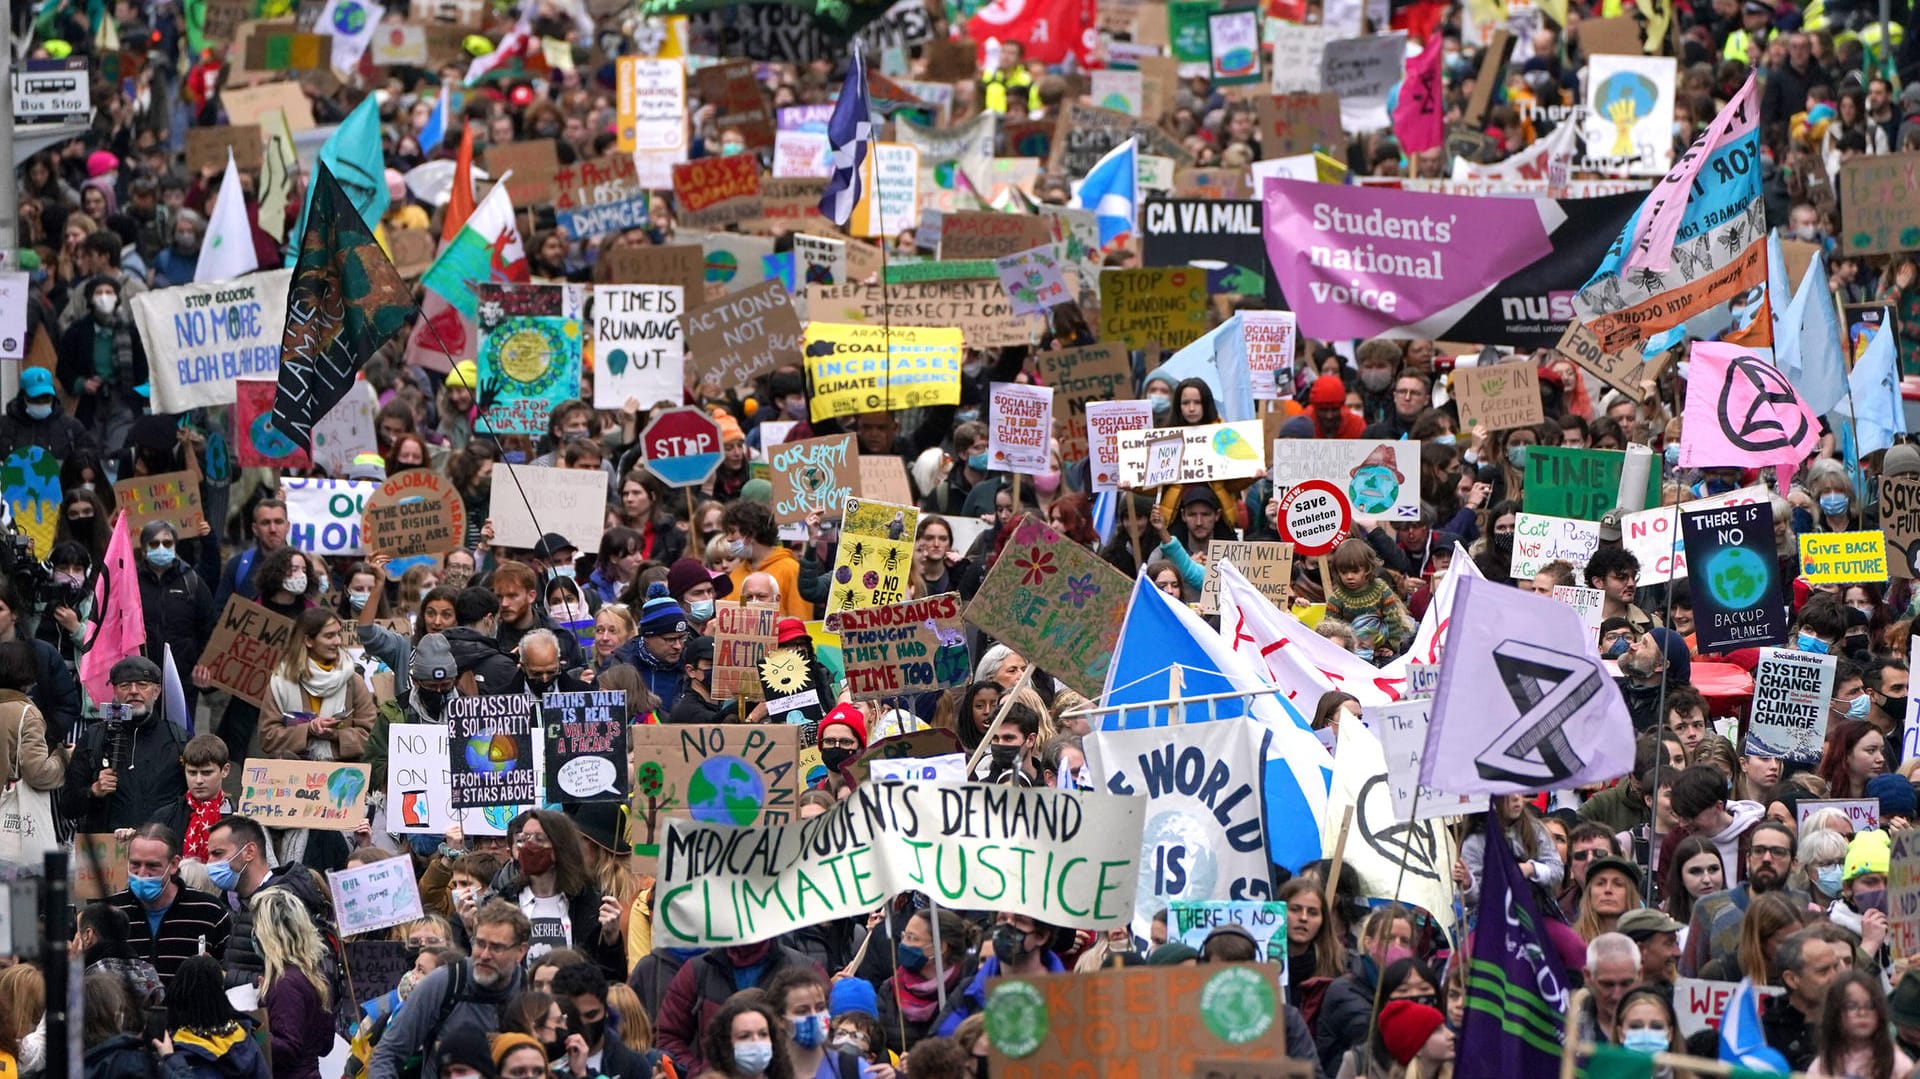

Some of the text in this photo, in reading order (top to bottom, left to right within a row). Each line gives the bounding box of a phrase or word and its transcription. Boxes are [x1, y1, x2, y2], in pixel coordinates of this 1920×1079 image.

[21, 99, 82, 111] Bus Stop
[674, 161, 732, 192] LOSS
[578, 179, 625, 206] LOSS
[573, 201, 647, 236] DAMAGE
[1179, 203, 1210, 234] VA
[1211, 203, 1261, 234] MAL
[817, 252, 837, 263] NO
[1310, 244, 1443, 281] national
[1110, 271, 1163, 295] STOP
[185, 292, 213, 308] STOP
[605, 289, 676, 312] TIME IS
[1113, 299, 1187, 315] FUNDING
[1309, 280, 1398, 314] voice
[688, 283, 788, 335] ACTIONS
[1501, 294, 1577, 322] nus
[174, 302, 262, 348] NO MORE
[599, 316, 681, 341] RUNNING
[722, 316, 766, 348] NOT
[1107, 317, 1169, 335] CLIMATE
[836, 343, 885, 353] COAL
[1566, 334, 1616, 373] FOOLS
[179, 347, 253, 386] BLAH BLAH
[704, 355, 742, 386] BLAH
[733, 351, 775, 383] BLAH
[818, 357, 958, 379] INCREASES
[818, 377, 876, 395] CLIMATE
[1513, 367, 1530, 389] IN
[514, 400, 549, 411] STOP
[994, 396, 1049, 411] SOCIALIST
[1000, 405, 1043, 419] CHANGE
[1461, 402, 1472, 418] A
[1005, 416, 1037, 428] TO END
[1091, 415, 1149, 427] SOCIALIST
[1484, 409, 1537, 428] FUTURE
[997, 425, 1043, 439] CLIMATE
[999, 434, 1042, 447] CHANGE
[773, 444, 809, 473] OUR
[1157, 445, 1178, 457] NOW
[1277, 440, 1356, 461] CLIMATE
[1160, 458, 1171, 469] OR
[1277, 460, 1350, 481] CHANGE
[1529, 452, 1606, 487] TIME
[383, 472, 440, 497] GLOBAL
[1150, 469, 1177, 482] NEVER
[1281, 487, 1305, 511] www.
[1295, 494, 1327, 513] save
[1566, 491, 1611, 519] UP
[371, 500, 442, 520] THE OCEANS
[1291, 508, 1337, 529] embleton
[1692, 507, 1758, 531] THERE IS
[378, 515, 440, 533] ARE RISING
[1296, 521, 1337, 540] beaches
[1518, 516, 1599, 550] Eat Pussy
[1631, 517, 1669, 539] NO
[379, 527, 449, 548] BUT SO ARE
[1330, 530, 1349, 550] .net
[1718, 528, 1744, 546] NO
[1806, 539, 1879, 555] GIVE BACK
[1211, 544, 1292, 562] EARTH WILL
[1519, 540, 1542, 559] Not
[1834, 557, 1884, 575] FUTURE
[883, 575, 899, 591] NO
[872, 589, 903, 606] BEES
[1587, 590, 1600, 608] THE
[224, 600, 260, 640] WE
[718, 607, 780, 635] CLIMATE
[841, 597, 957, 631] DINOSAURS
[1714, 608, 1765, 628] BACKUP
[844, 626, 917, 644] THOUGHT
[1730, 623, 1771, 641] PLANET
[228, 635, 279, 673] REAL
[844, 641, 927, 663] THEY HAD
[1773, 650, 1824, 665] Socialist Worker
[846, 664, 934, 694] TIME TOO
[1761, 661, 1821, 680] SYSTEM
[1759, 674, 1822, 693] CHANGE
[543, 692, 626, 709] EARTHS VALUE
[1758, 686, 1789, 702] NOT
[448, 694, 531, 719] COMPASSION
[561, 707, 613, 723] IS REAL
[1756, 698, 1820, 718] CLIMATE
[449, 715, 532, 739] & SOLIDARITY
[563, 721, 621, 737] VALUE IS
[1754, 711, 1816, 729] CHANGE
[397, 735, 427, 755] NO
[557, 737, 614, 753] A FACADE
[680, 727, 726, 764] NO
[396, 768, 428, 787] ON
[452, 770, 534, 788] FROM THE CORE
[463, 784, 535, 803] STARS ABOVE
[1138, 743, 1264, 853] WORLD
[663, 783, 1084, 883] MEDICAL STUDENTS DEMAND
[1154, 845, 1187, 896] IS
[661, 836, 1131, 944] CLIMATE JUSTICE
[1170, 908, 1276, 929] THERE IS NO
[1043, 971, 1201, 1017] KEEP
[1052, 1014, 1201, 1058] YOUR
